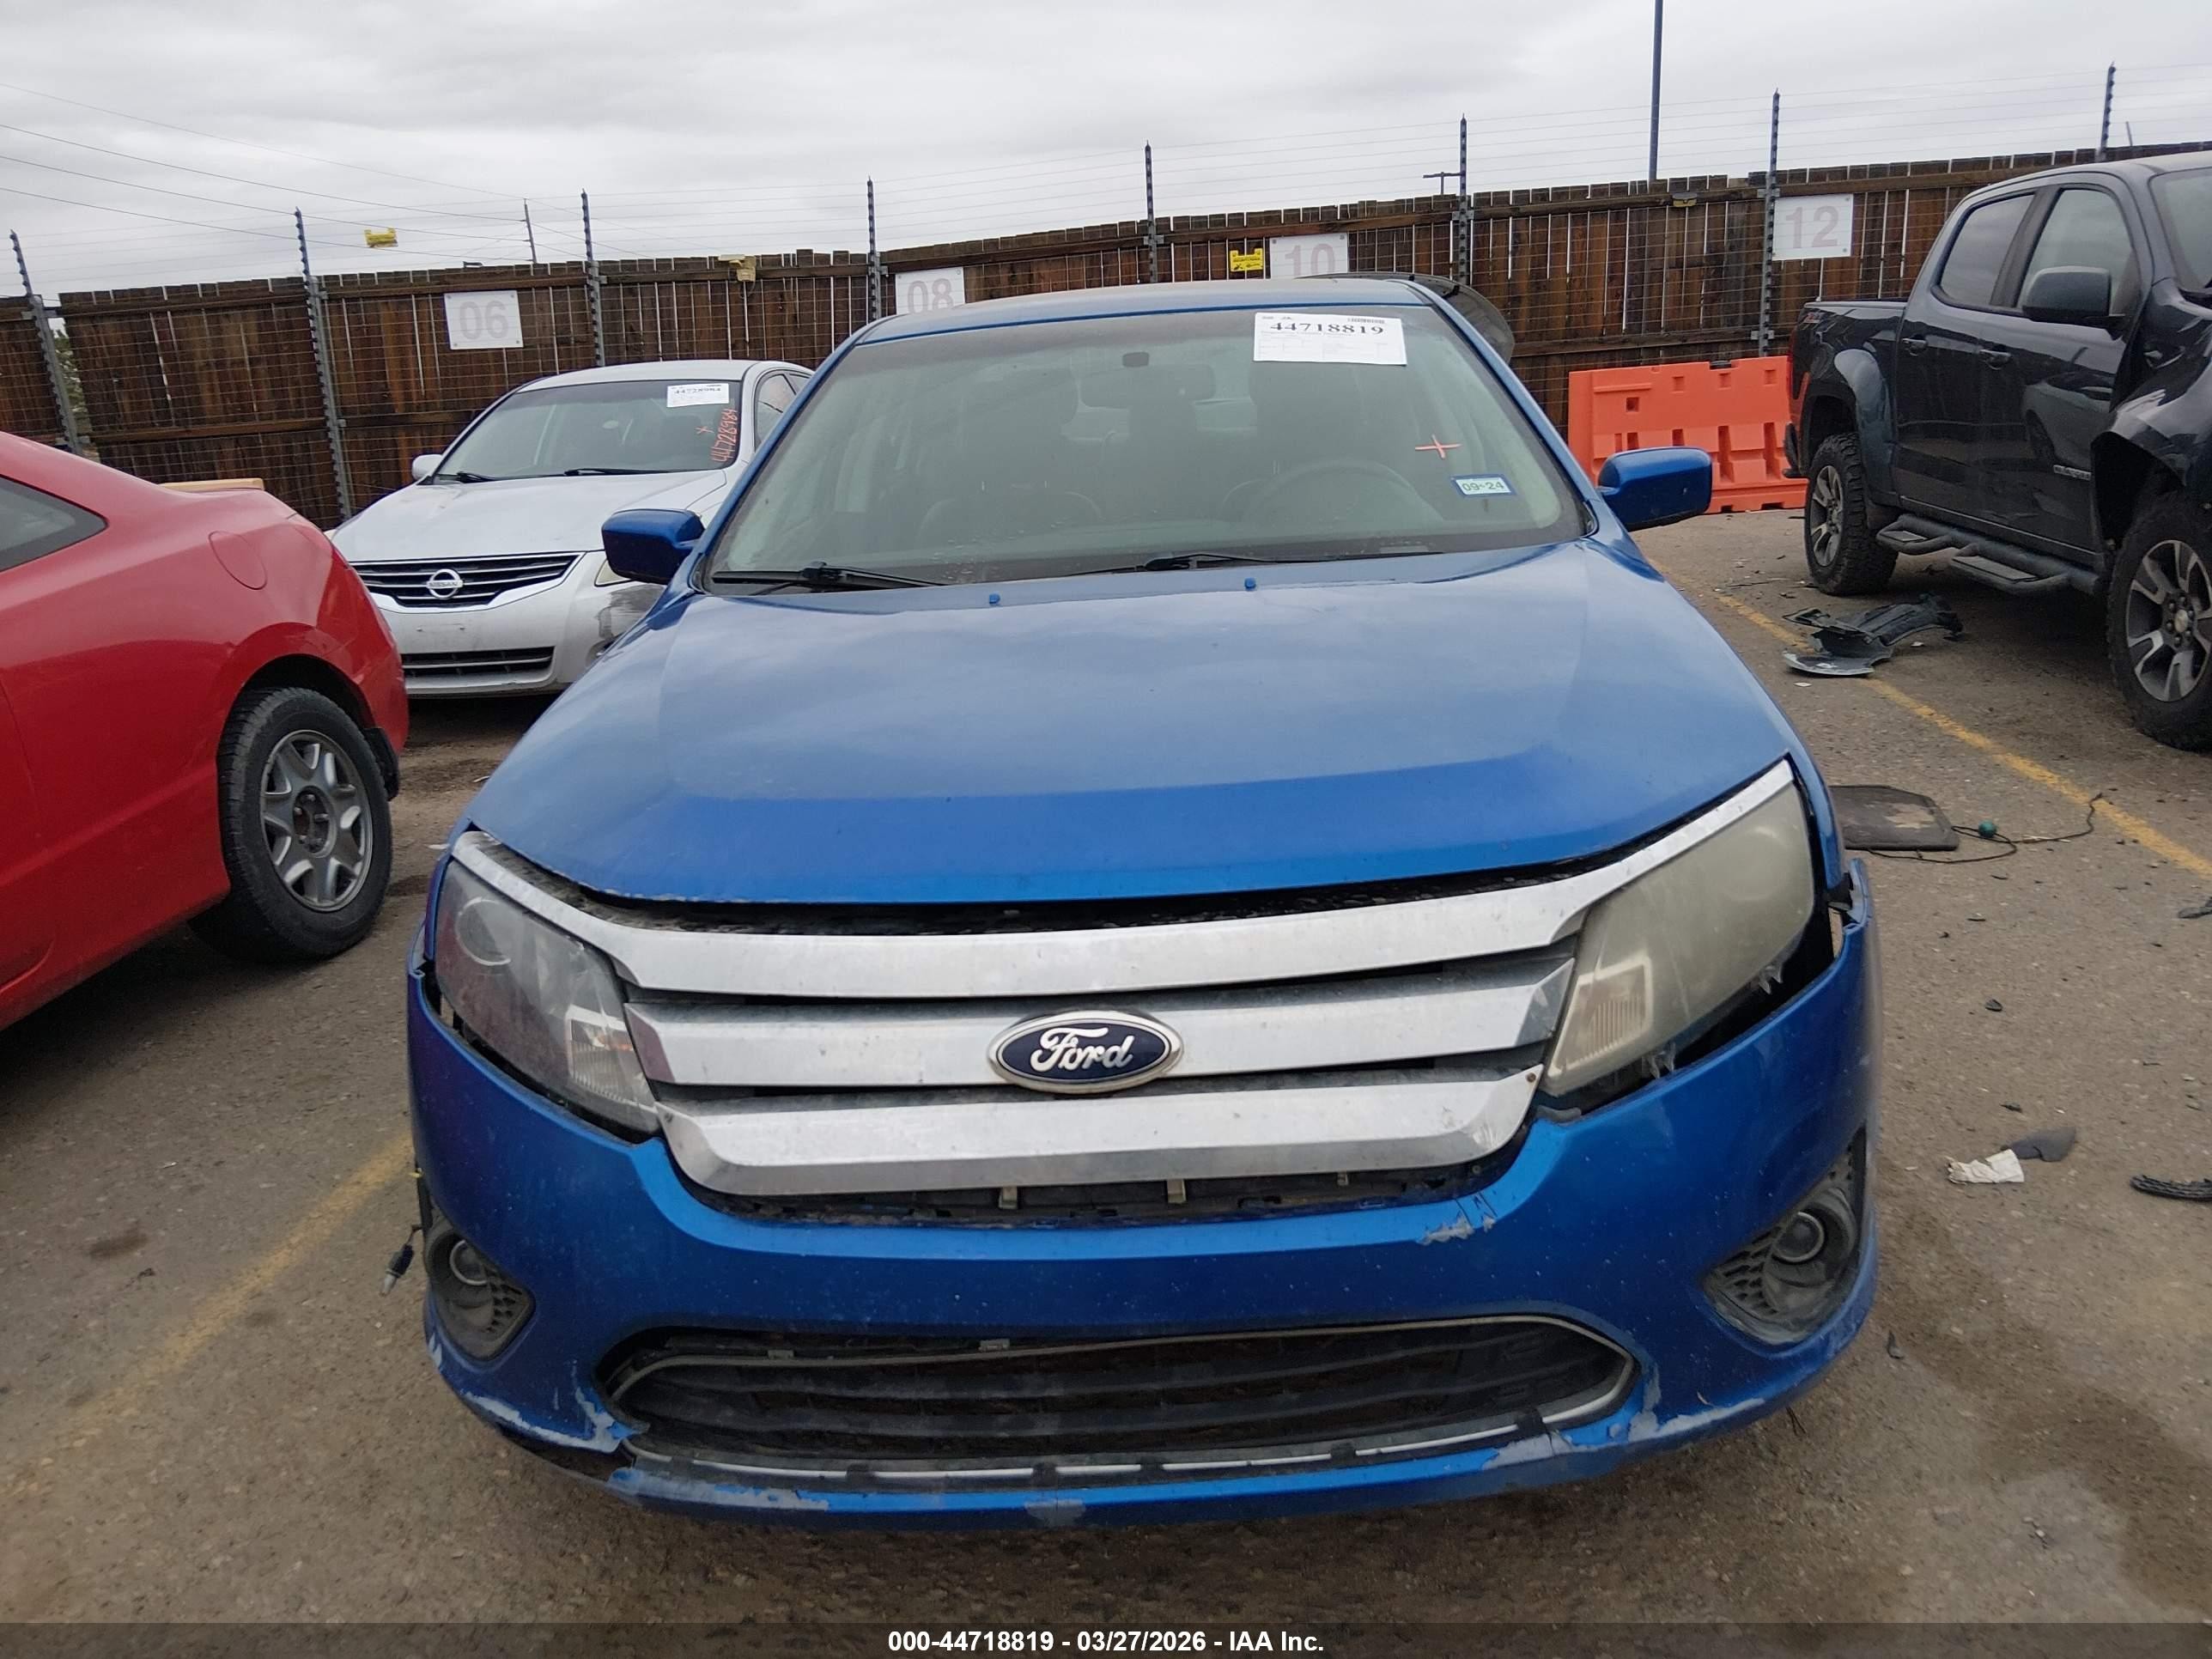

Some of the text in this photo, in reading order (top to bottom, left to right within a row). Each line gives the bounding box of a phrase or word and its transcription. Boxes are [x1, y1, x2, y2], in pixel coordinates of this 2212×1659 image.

[1785, 205, 1839, 248] 12
[1285, 243, 1336, 276] 10
[907, 278, 955, 314] 08
[459, 300, 509, 340] 06
[1270, 322, 1384, 335] 44718819
[1030, 1027, 1135, 1072] Ford
